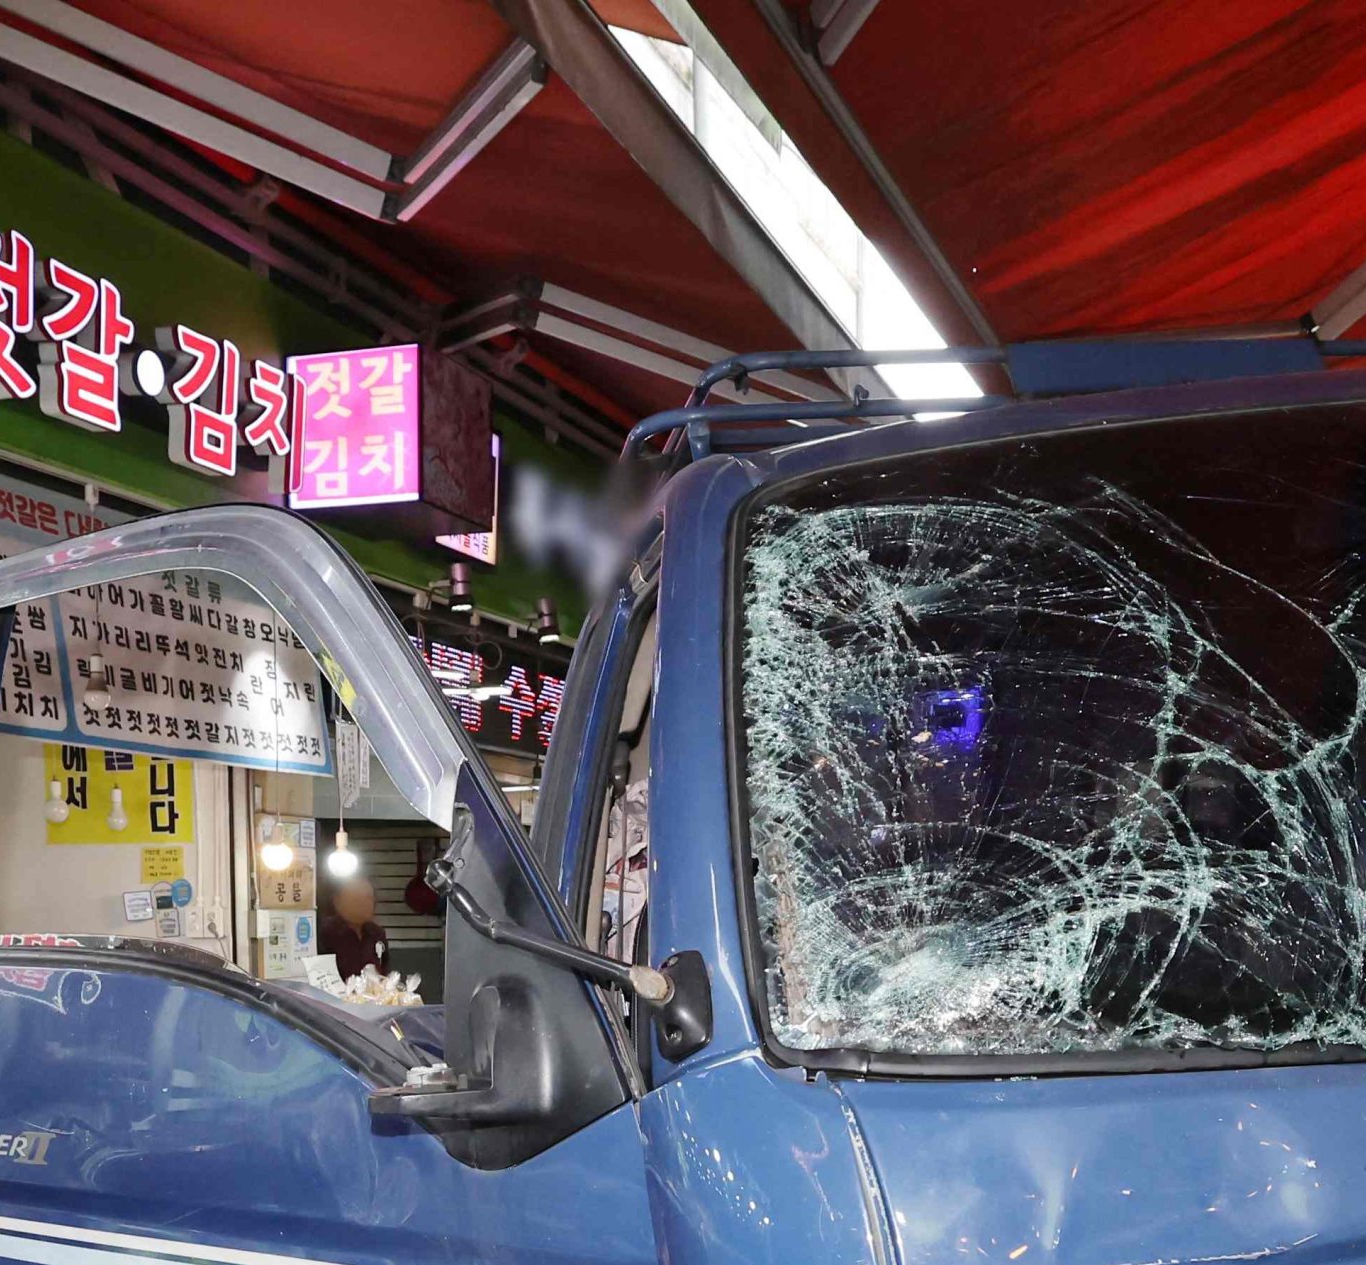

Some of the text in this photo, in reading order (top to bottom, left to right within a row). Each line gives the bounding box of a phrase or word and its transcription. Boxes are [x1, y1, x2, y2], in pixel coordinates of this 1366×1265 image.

[306, 351, 413, 421] 젓갈
[303, 431, 406, 497] 김치
[150, 757, 179, 834] 니다
